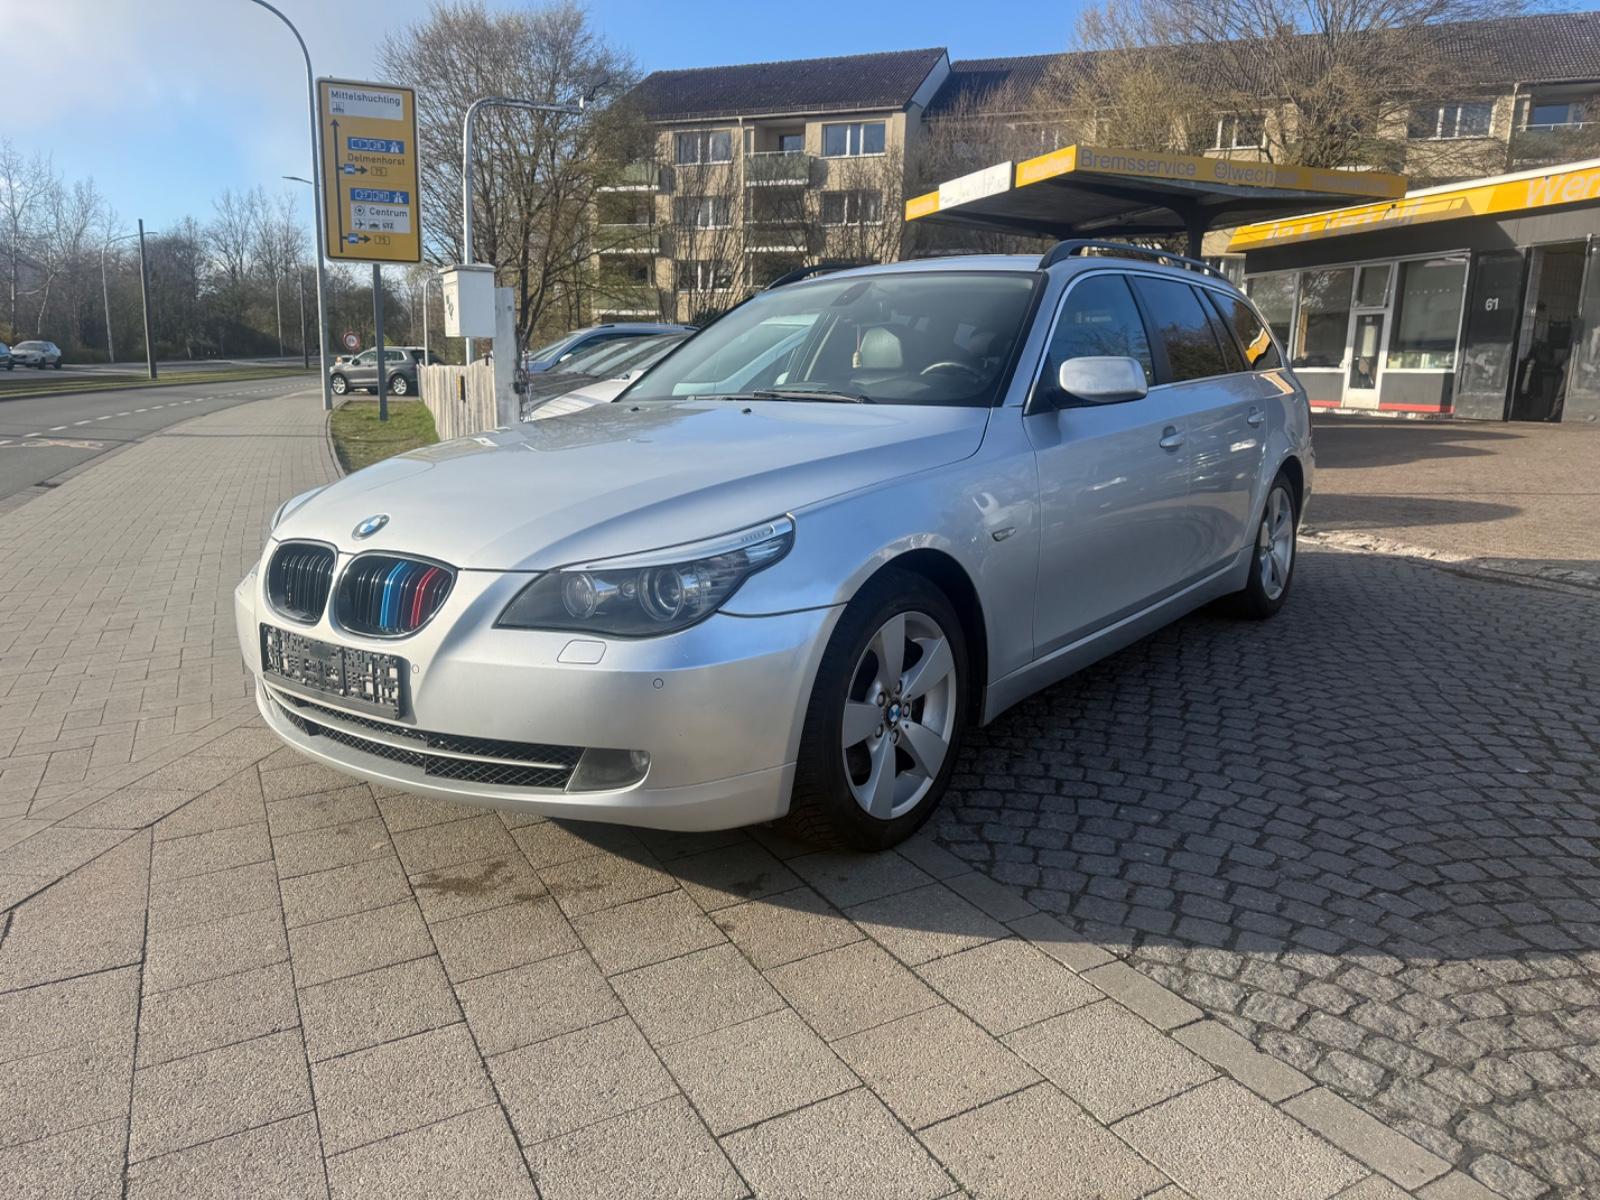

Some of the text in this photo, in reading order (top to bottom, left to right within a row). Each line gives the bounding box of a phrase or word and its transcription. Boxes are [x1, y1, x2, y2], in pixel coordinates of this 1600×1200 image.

[331, 90, 400, 107] Mittelshuchting
[347, 152, 405, 166] Delmenhorst
[1080, 148, 1196, 177] Bremsservice
[1525, 173, 1600, 208] Wer
[369, 206, 407, 218] Centrum
[1485, 298, 1499, 311] 61
